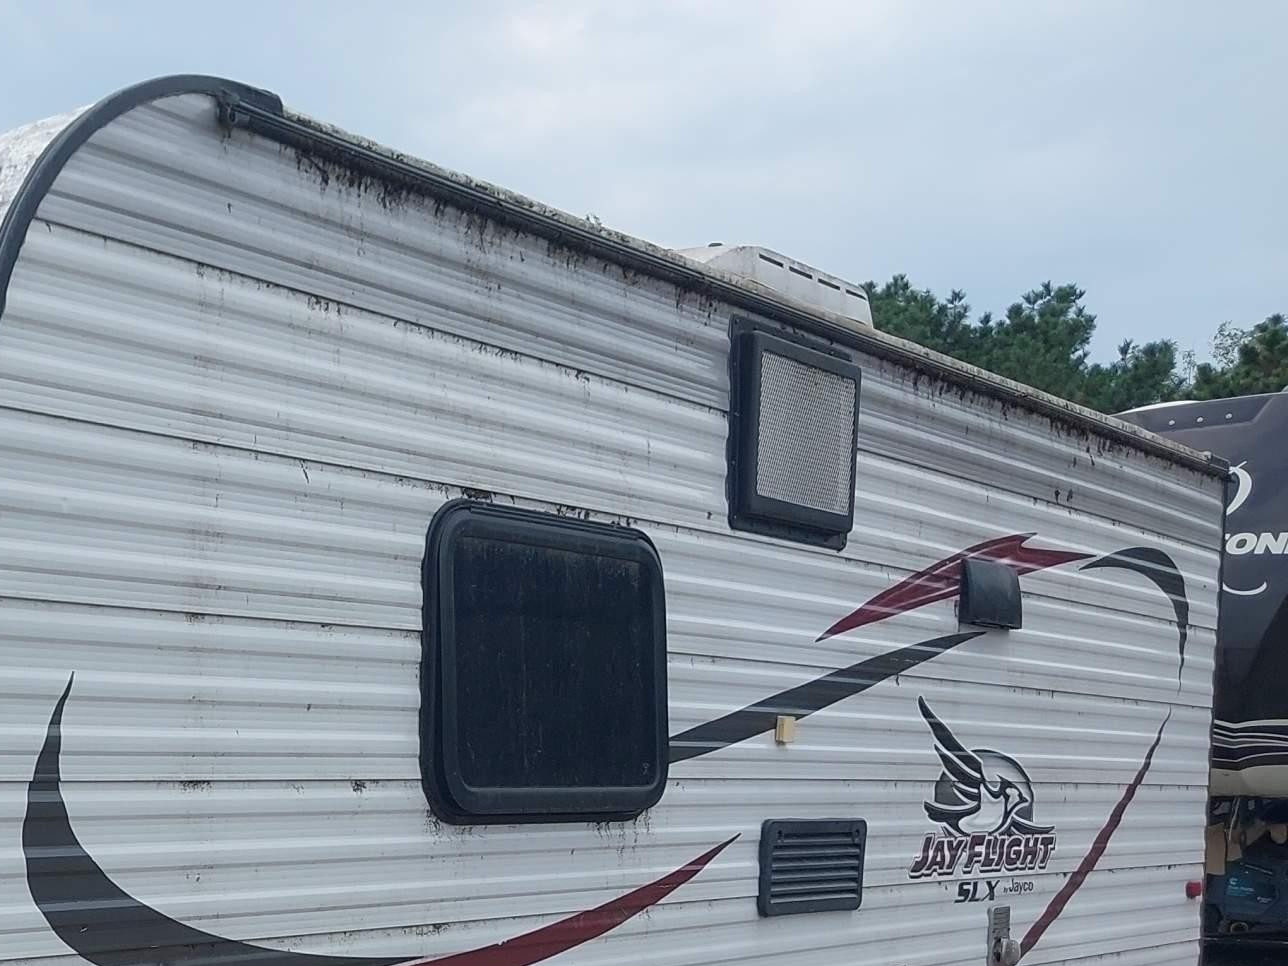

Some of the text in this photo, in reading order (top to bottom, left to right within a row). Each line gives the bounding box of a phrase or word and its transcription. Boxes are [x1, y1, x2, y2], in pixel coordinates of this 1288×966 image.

[1224, 532, 1288, 555] ON
[910, 832, 1056, 878] JAY FLIGHT
[954, 880, 1000, 903] SLX
[1009, 878, 1034, 895] Jayco
